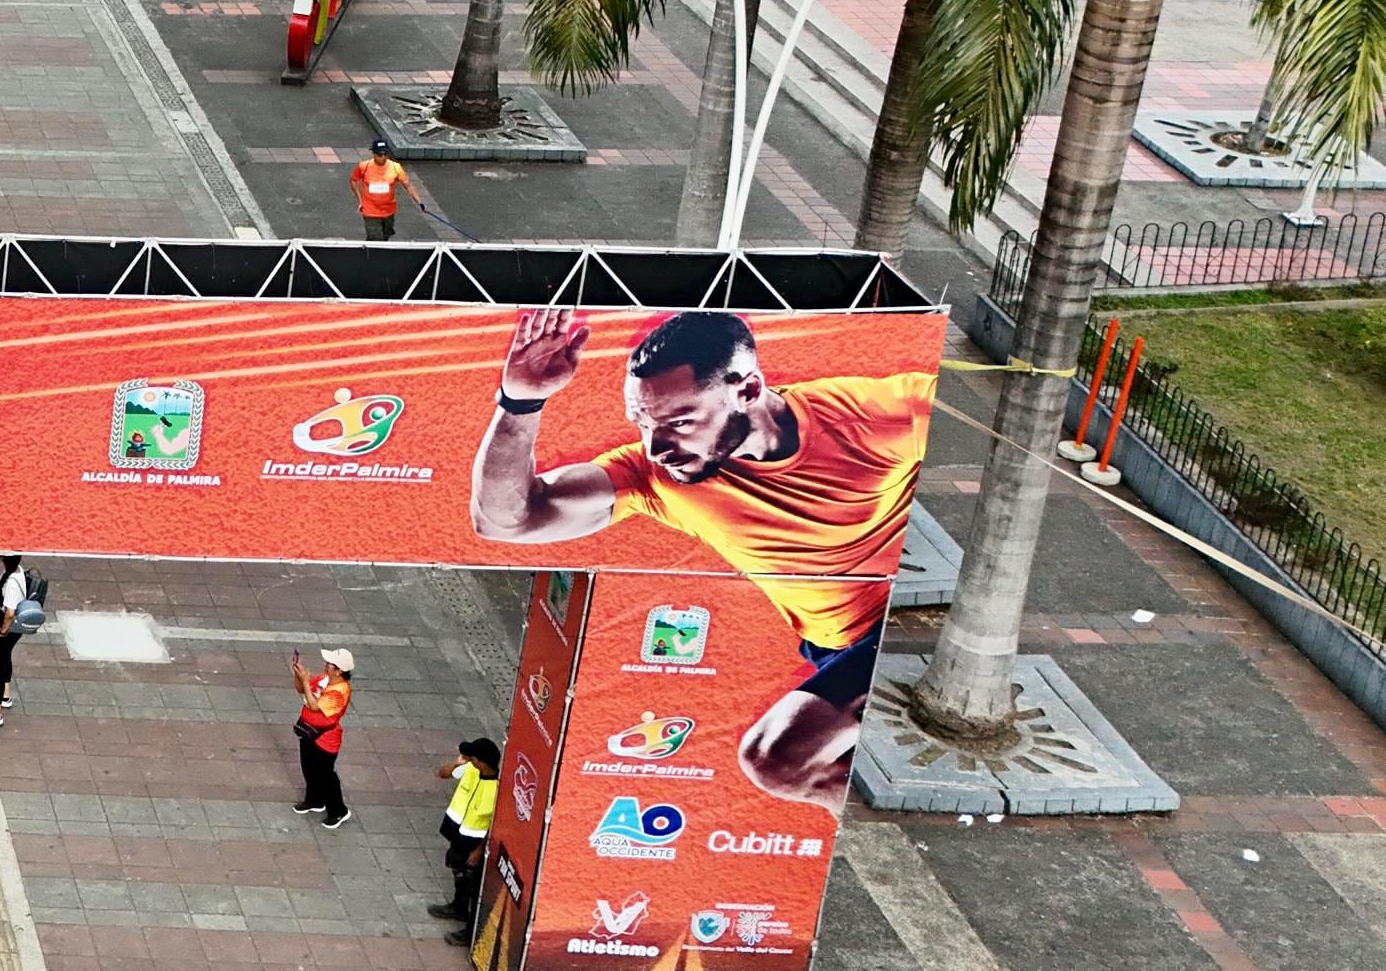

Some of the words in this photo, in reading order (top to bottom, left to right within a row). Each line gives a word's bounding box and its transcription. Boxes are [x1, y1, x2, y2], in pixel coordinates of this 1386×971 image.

[262, 459, 434, 478] ImderPalmira
[81, 471, 142, 484] ALCALDÍA
[147, 474, 163, 484] DE
[167, 474, 221, 486] PALMIRA
[620, 663, 662, 674] ALCALDÍA
[665, 666, 677, 675] DE
[679, 666, 717, 676] PALMIRA
[583, 760, 715, 776] ImderPalmira
[593, 837, 629, 847] AQUA
[707, 830, 793, 856] Cubitt
[598, 847, 674, 858] OCCIDENTE
[566, 938, 660, 958] Atletismo
